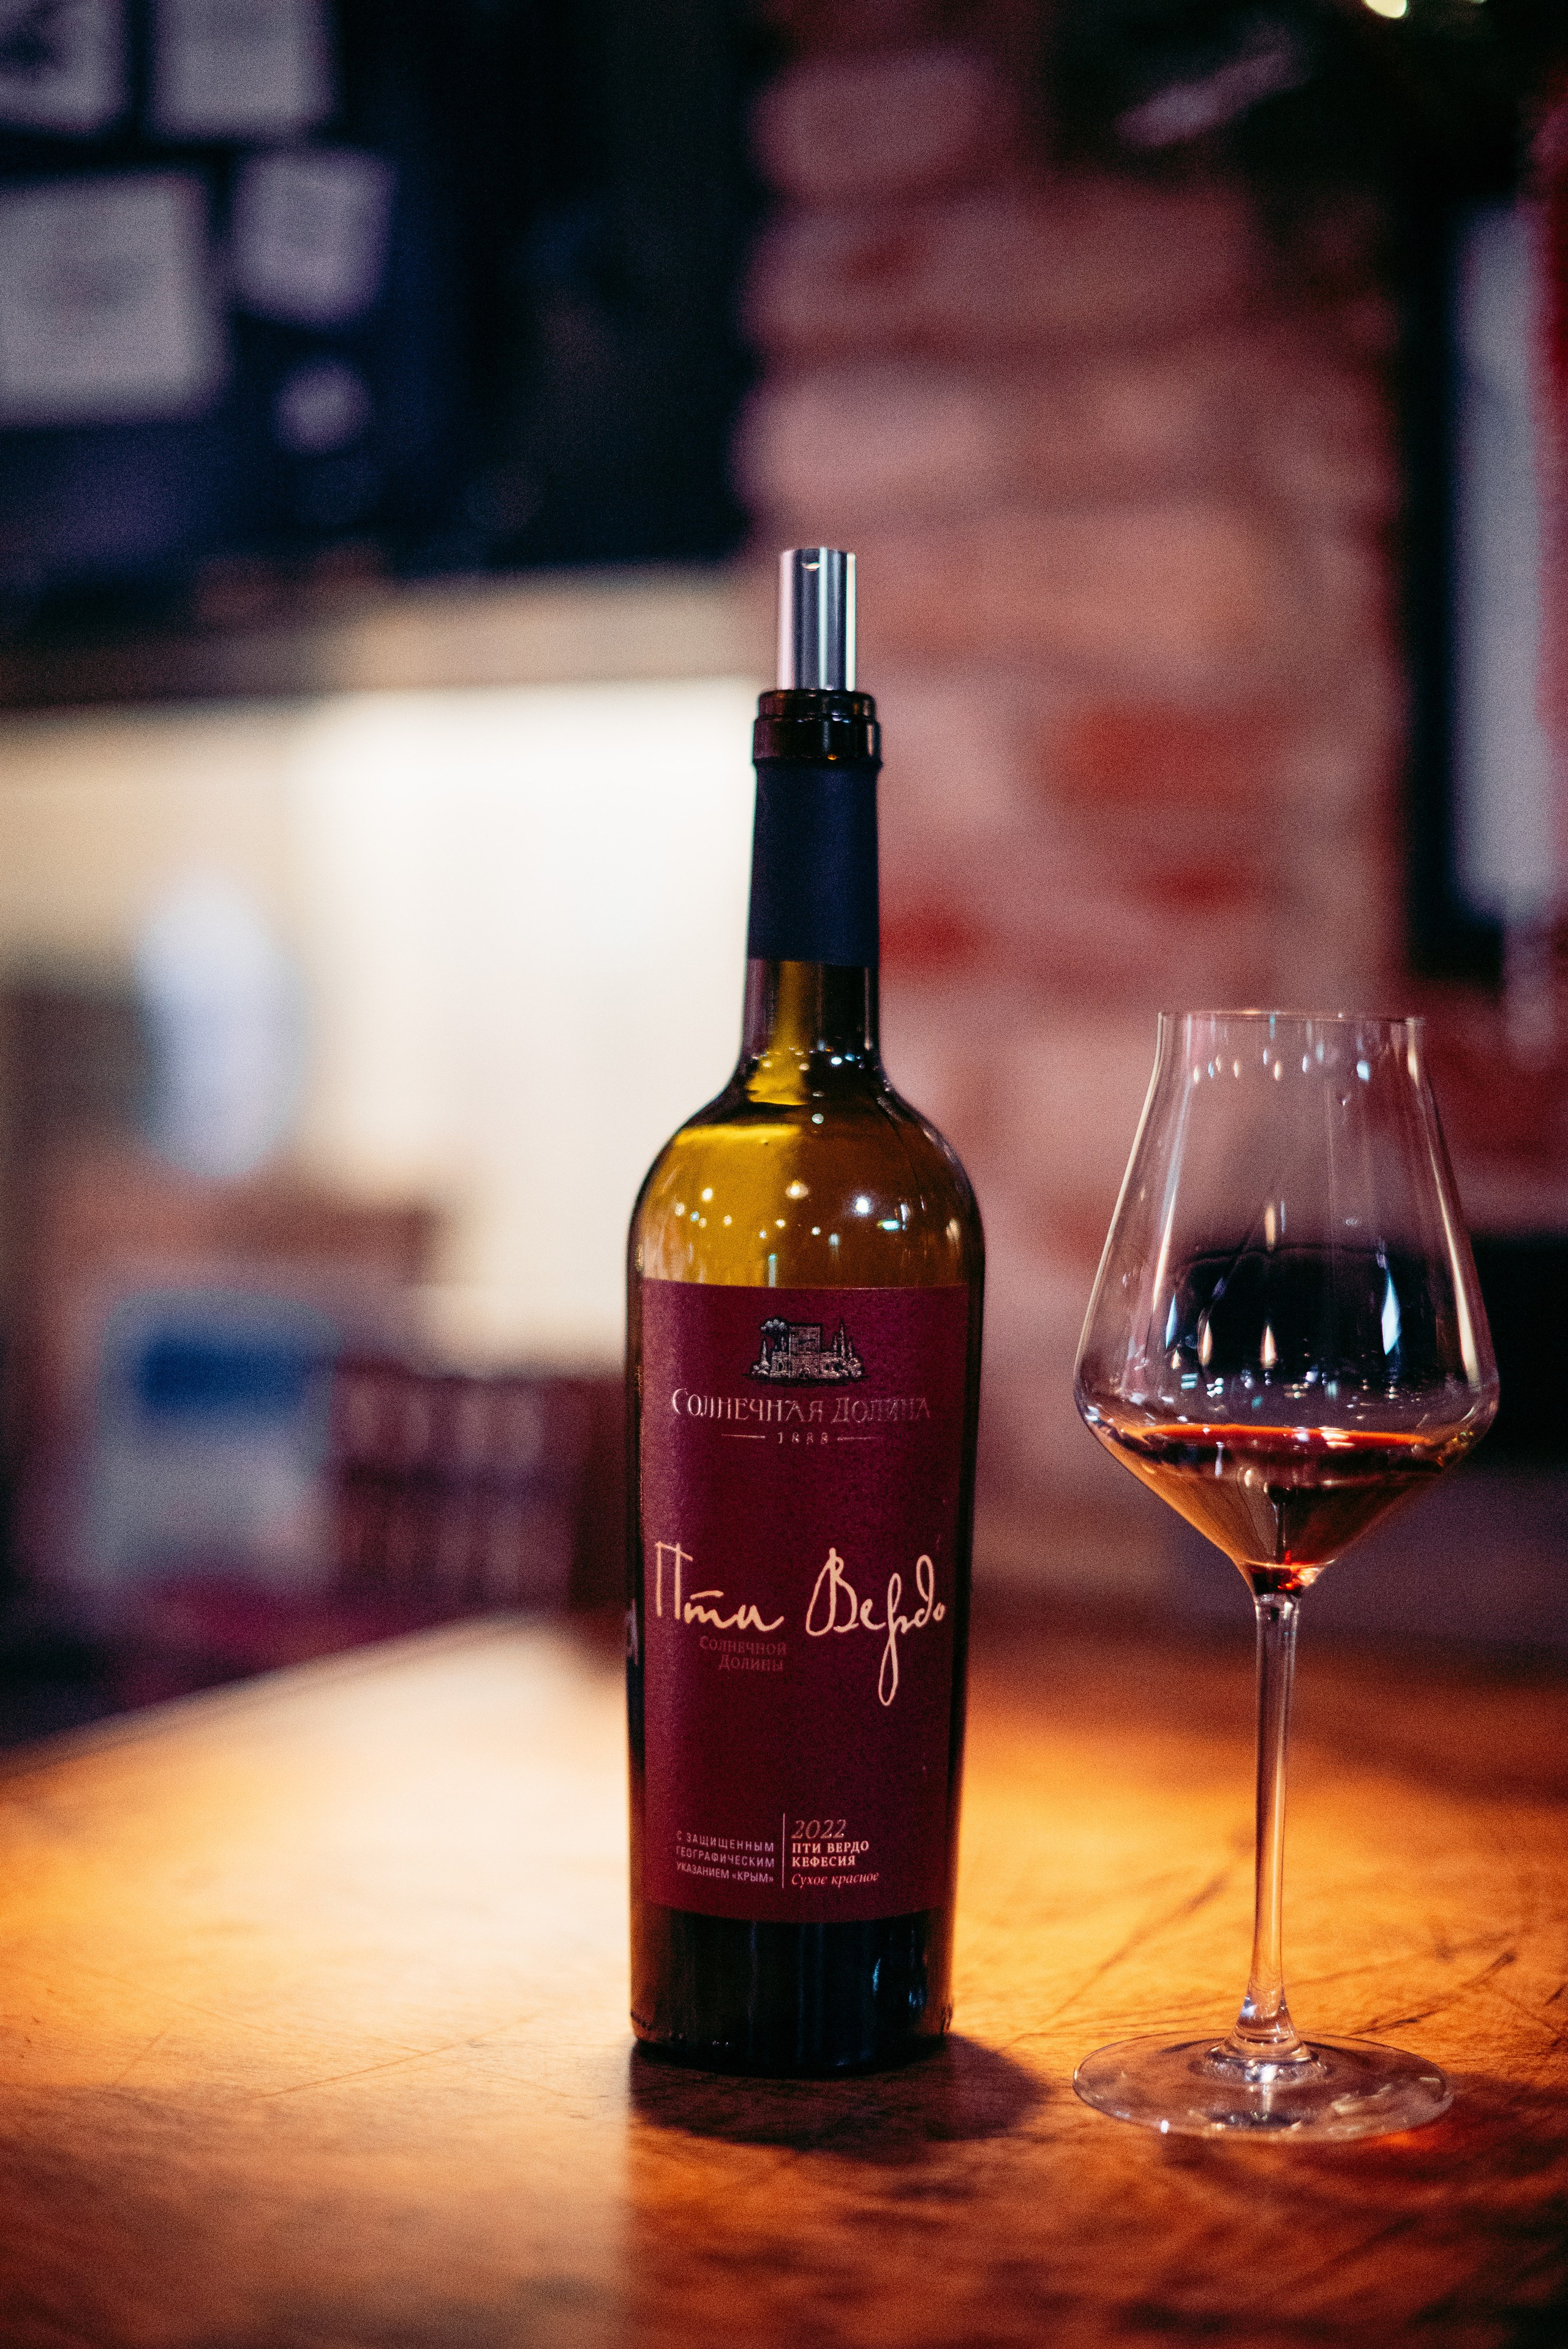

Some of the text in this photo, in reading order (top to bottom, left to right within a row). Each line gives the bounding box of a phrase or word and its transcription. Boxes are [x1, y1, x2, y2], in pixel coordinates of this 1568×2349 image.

[672, 1388, 931, 1424] СОЛНЕЧНАЯ ДОЛИНА
[777, 1432, 829, 1445] 1888
[655, 1541, 946, 1706] Пти Вердо
[791, 1818, 847, 1839] 2022
[676, 1829, 774, 1853] С ЗАЩИЩЕННЫМ
[792, 1840, 870, 1854] ПТИ ВЕРДО
[676, 1845, 775, 1868] ГЕОГРАФИЧЕСКИМ
[792, 1855, 856, 1868] КЕФЕСИЯ
[676, 1861, 774, 1883] УКАЗАНИЕМ «КРЫМ»
[791, 1872, 880, 1889] Сухое красное
